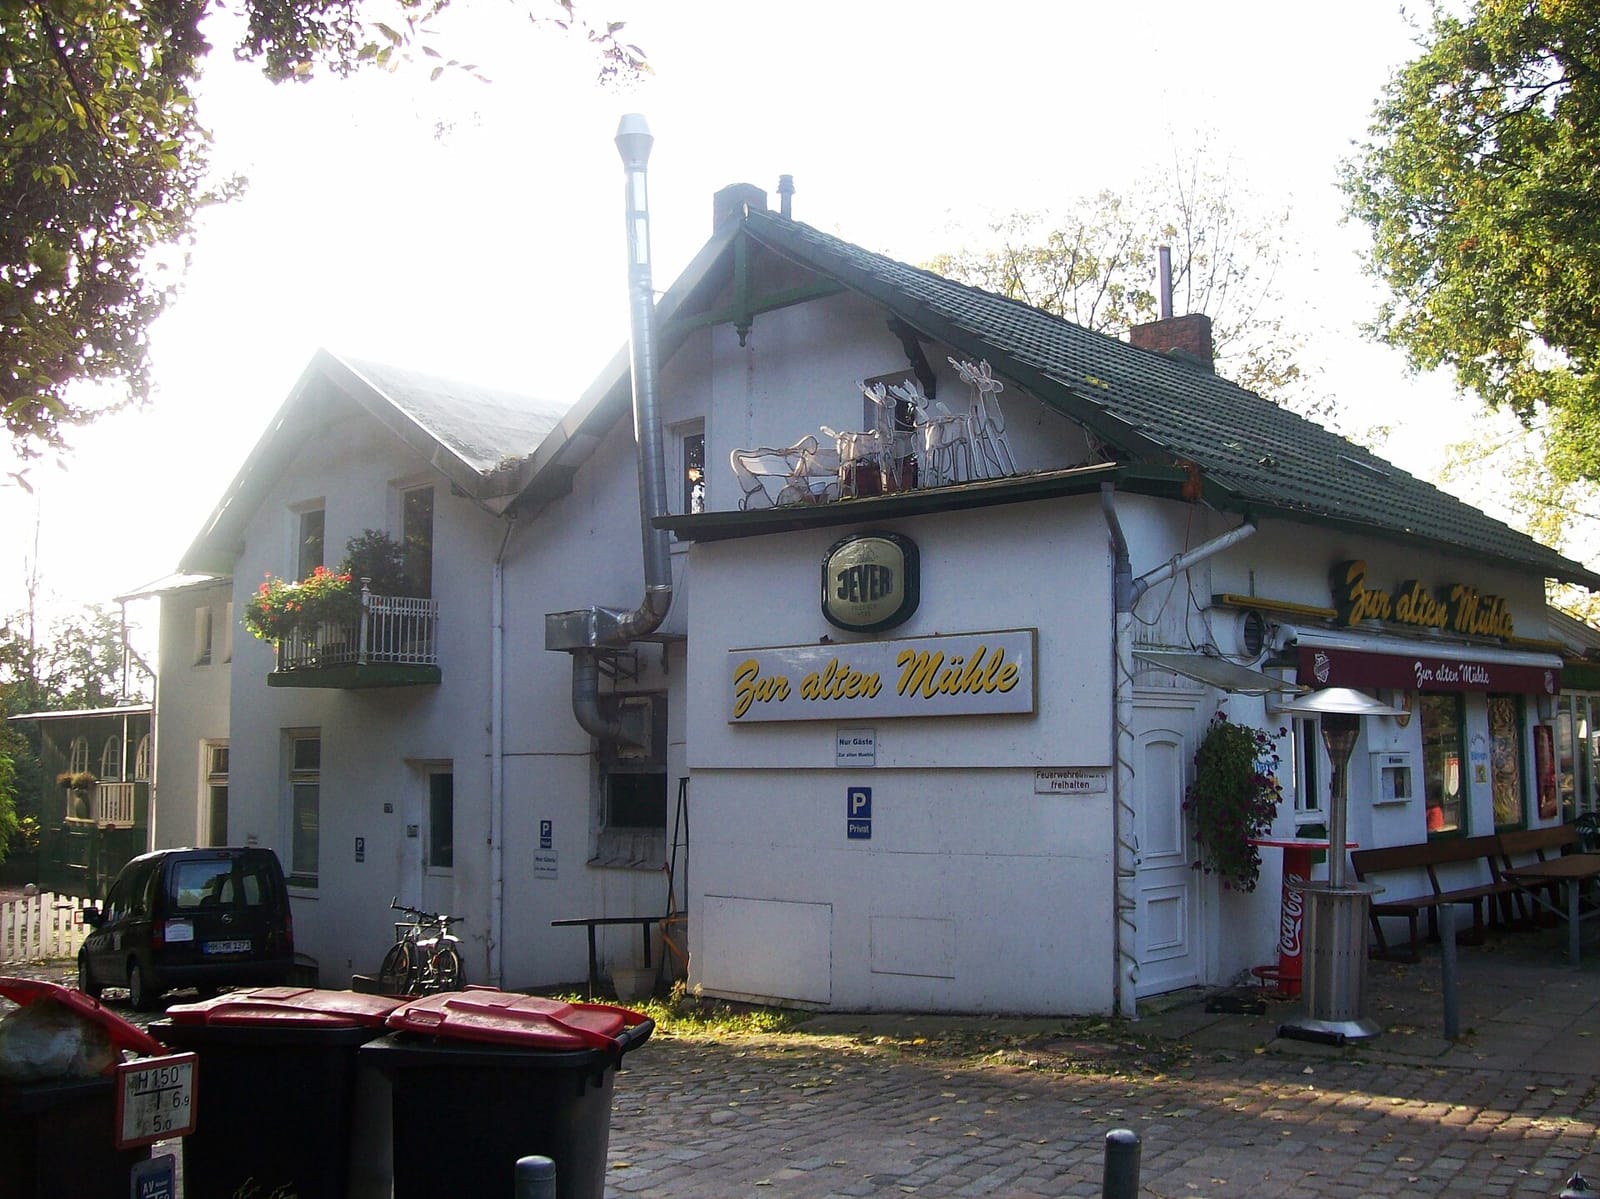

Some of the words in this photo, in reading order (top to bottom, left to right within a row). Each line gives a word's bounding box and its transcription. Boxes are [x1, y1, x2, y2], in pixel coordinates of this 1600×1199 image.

[837, 564, 893, 603] JEVER
[1346, 559, 1391, 626] Zur
[1396, 581, 1449, 629] alten
[1451, 584, 1514, 638] Mühle
[733, 658, 791, 718] Zur
[799, 657, 882, 701] alten
[896, 645, 1019, 699] Mühle
[1414, 661, 1433, 688] Zur
[1436, 664, 1459, 683] alten
[1459, 664, 1489, 685] Mühle
[853, 738, 873, 746] Gäste
[1051, 780, 1090, 789] freihalten
[852, 792, 867, 815] P
[542, 822, 550, 836] P
[849, 824, 869, 834] Privat
[142, 1180, 154, 1195] AV
